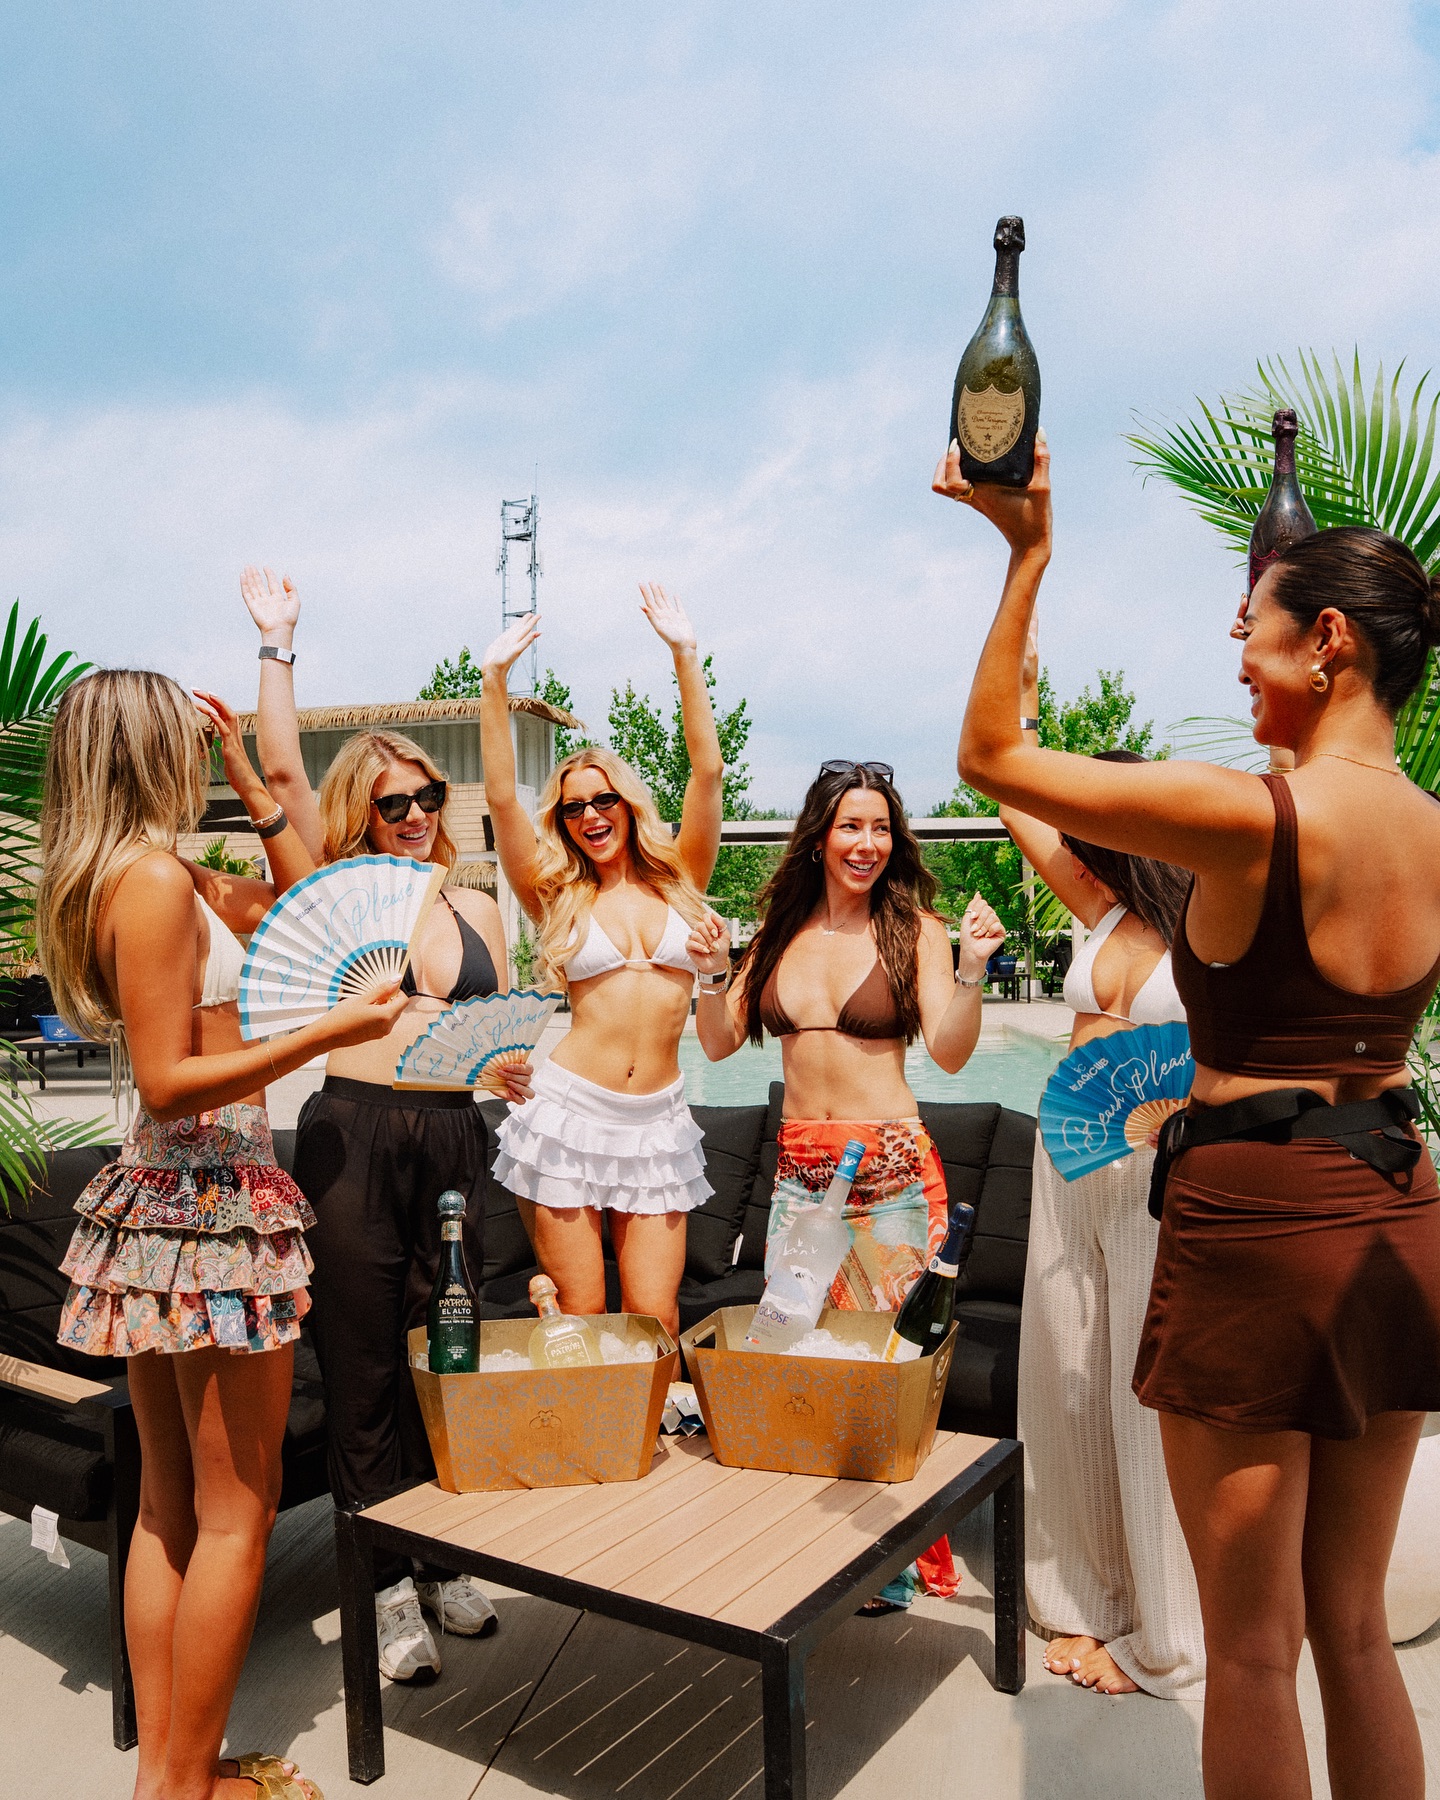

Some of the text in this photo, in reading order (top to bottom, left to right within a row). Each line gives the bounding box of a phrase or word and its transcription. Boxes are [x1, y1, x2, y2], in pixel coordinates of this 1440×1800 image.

[329, 881, 415, 943] Please
[1110, 1047, 1192, 1101] Please
[438, 1297, 473, 1308] PATRÓN
